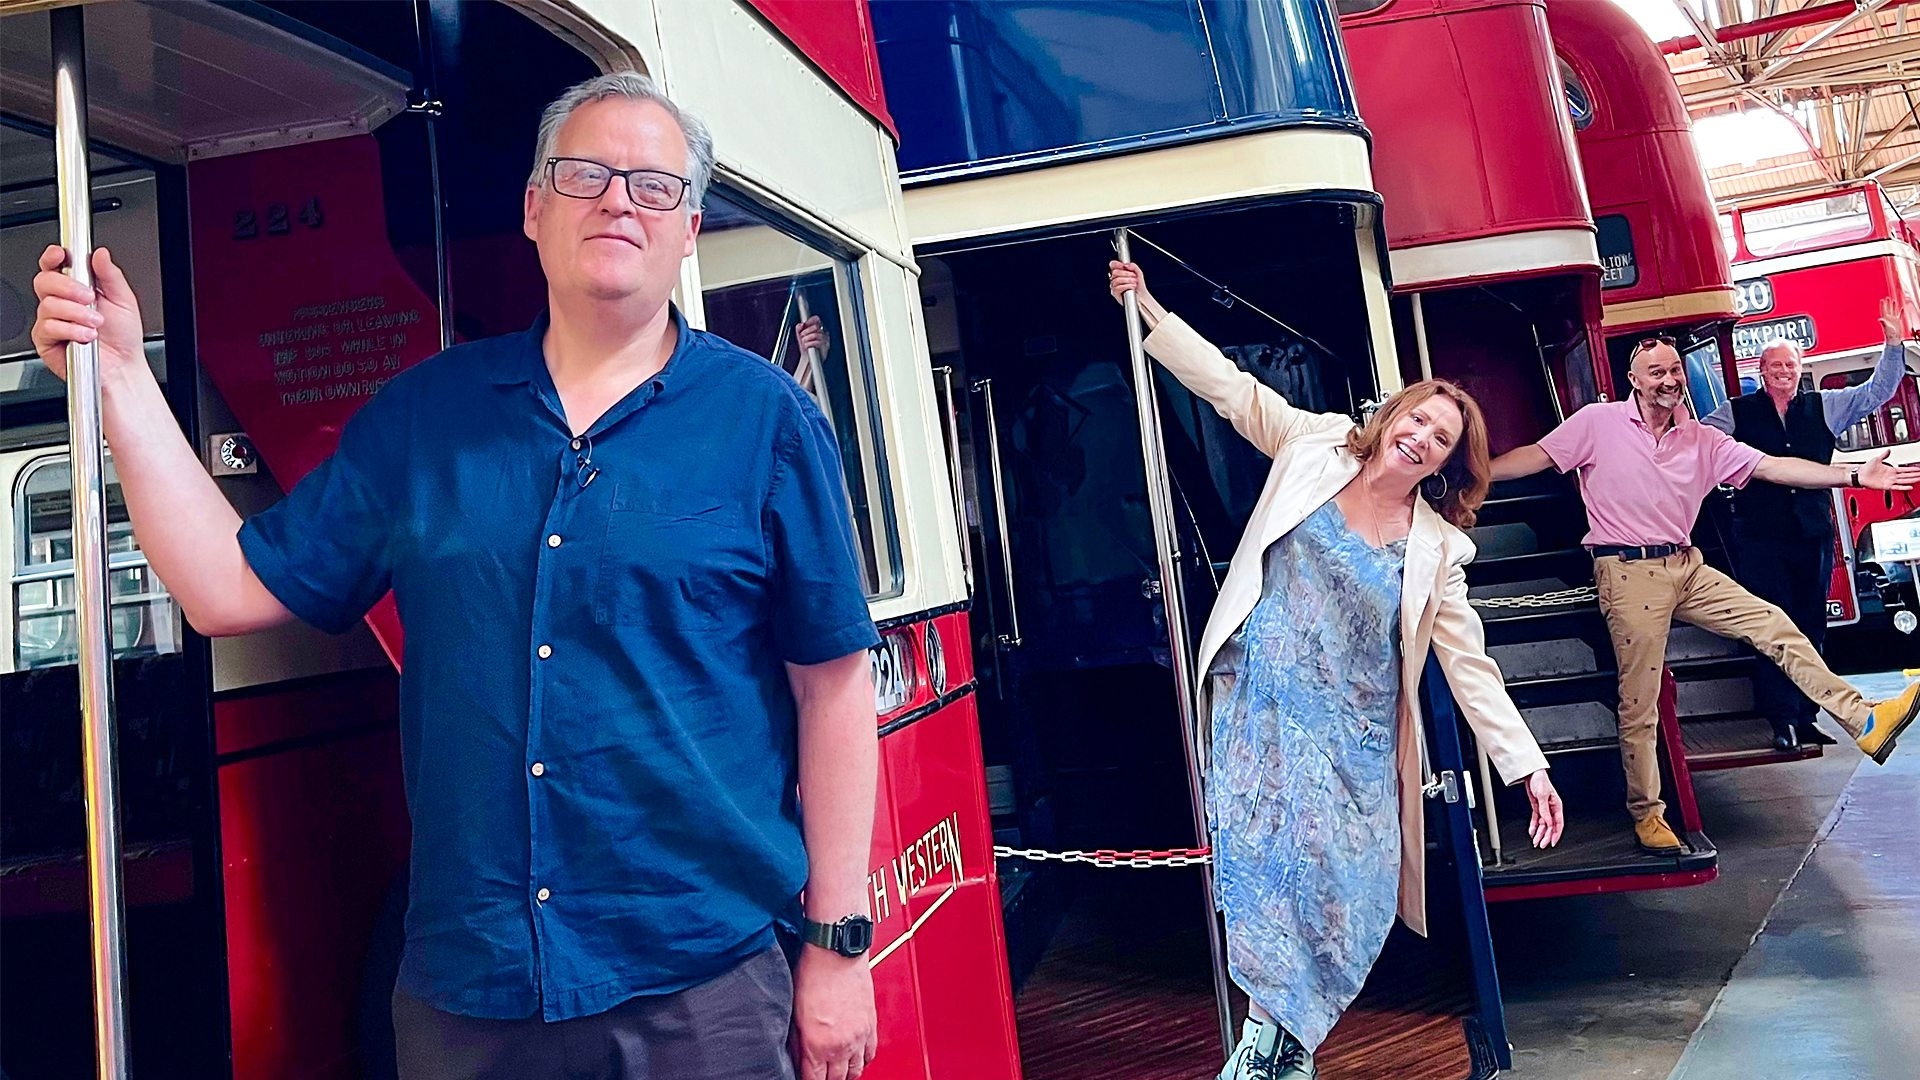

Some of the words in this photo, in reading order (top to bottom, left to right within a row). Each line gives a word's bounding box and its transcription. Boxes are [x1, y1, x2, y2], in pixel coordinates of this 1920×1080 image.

[233, 198, 323, 241] 224
[356, 309, 420, 332] LEAVING
[342, 335, 386, 355] WHILE
[390, 332, 406, 348] IN
[274, 364, 331, 385] MOTION
[334, 361, 355, 378] DO
[357, 358, 378, 373] SO
[282, 386, 323, 406] THEIR
[324, 381, 361, 399] OWN
[361, 376, 391, 395] RIS
[222, 440, 236, 467] PUSH
[869, 643, 905, 709] 224
[892, 811, 964, 905] WESTERN
